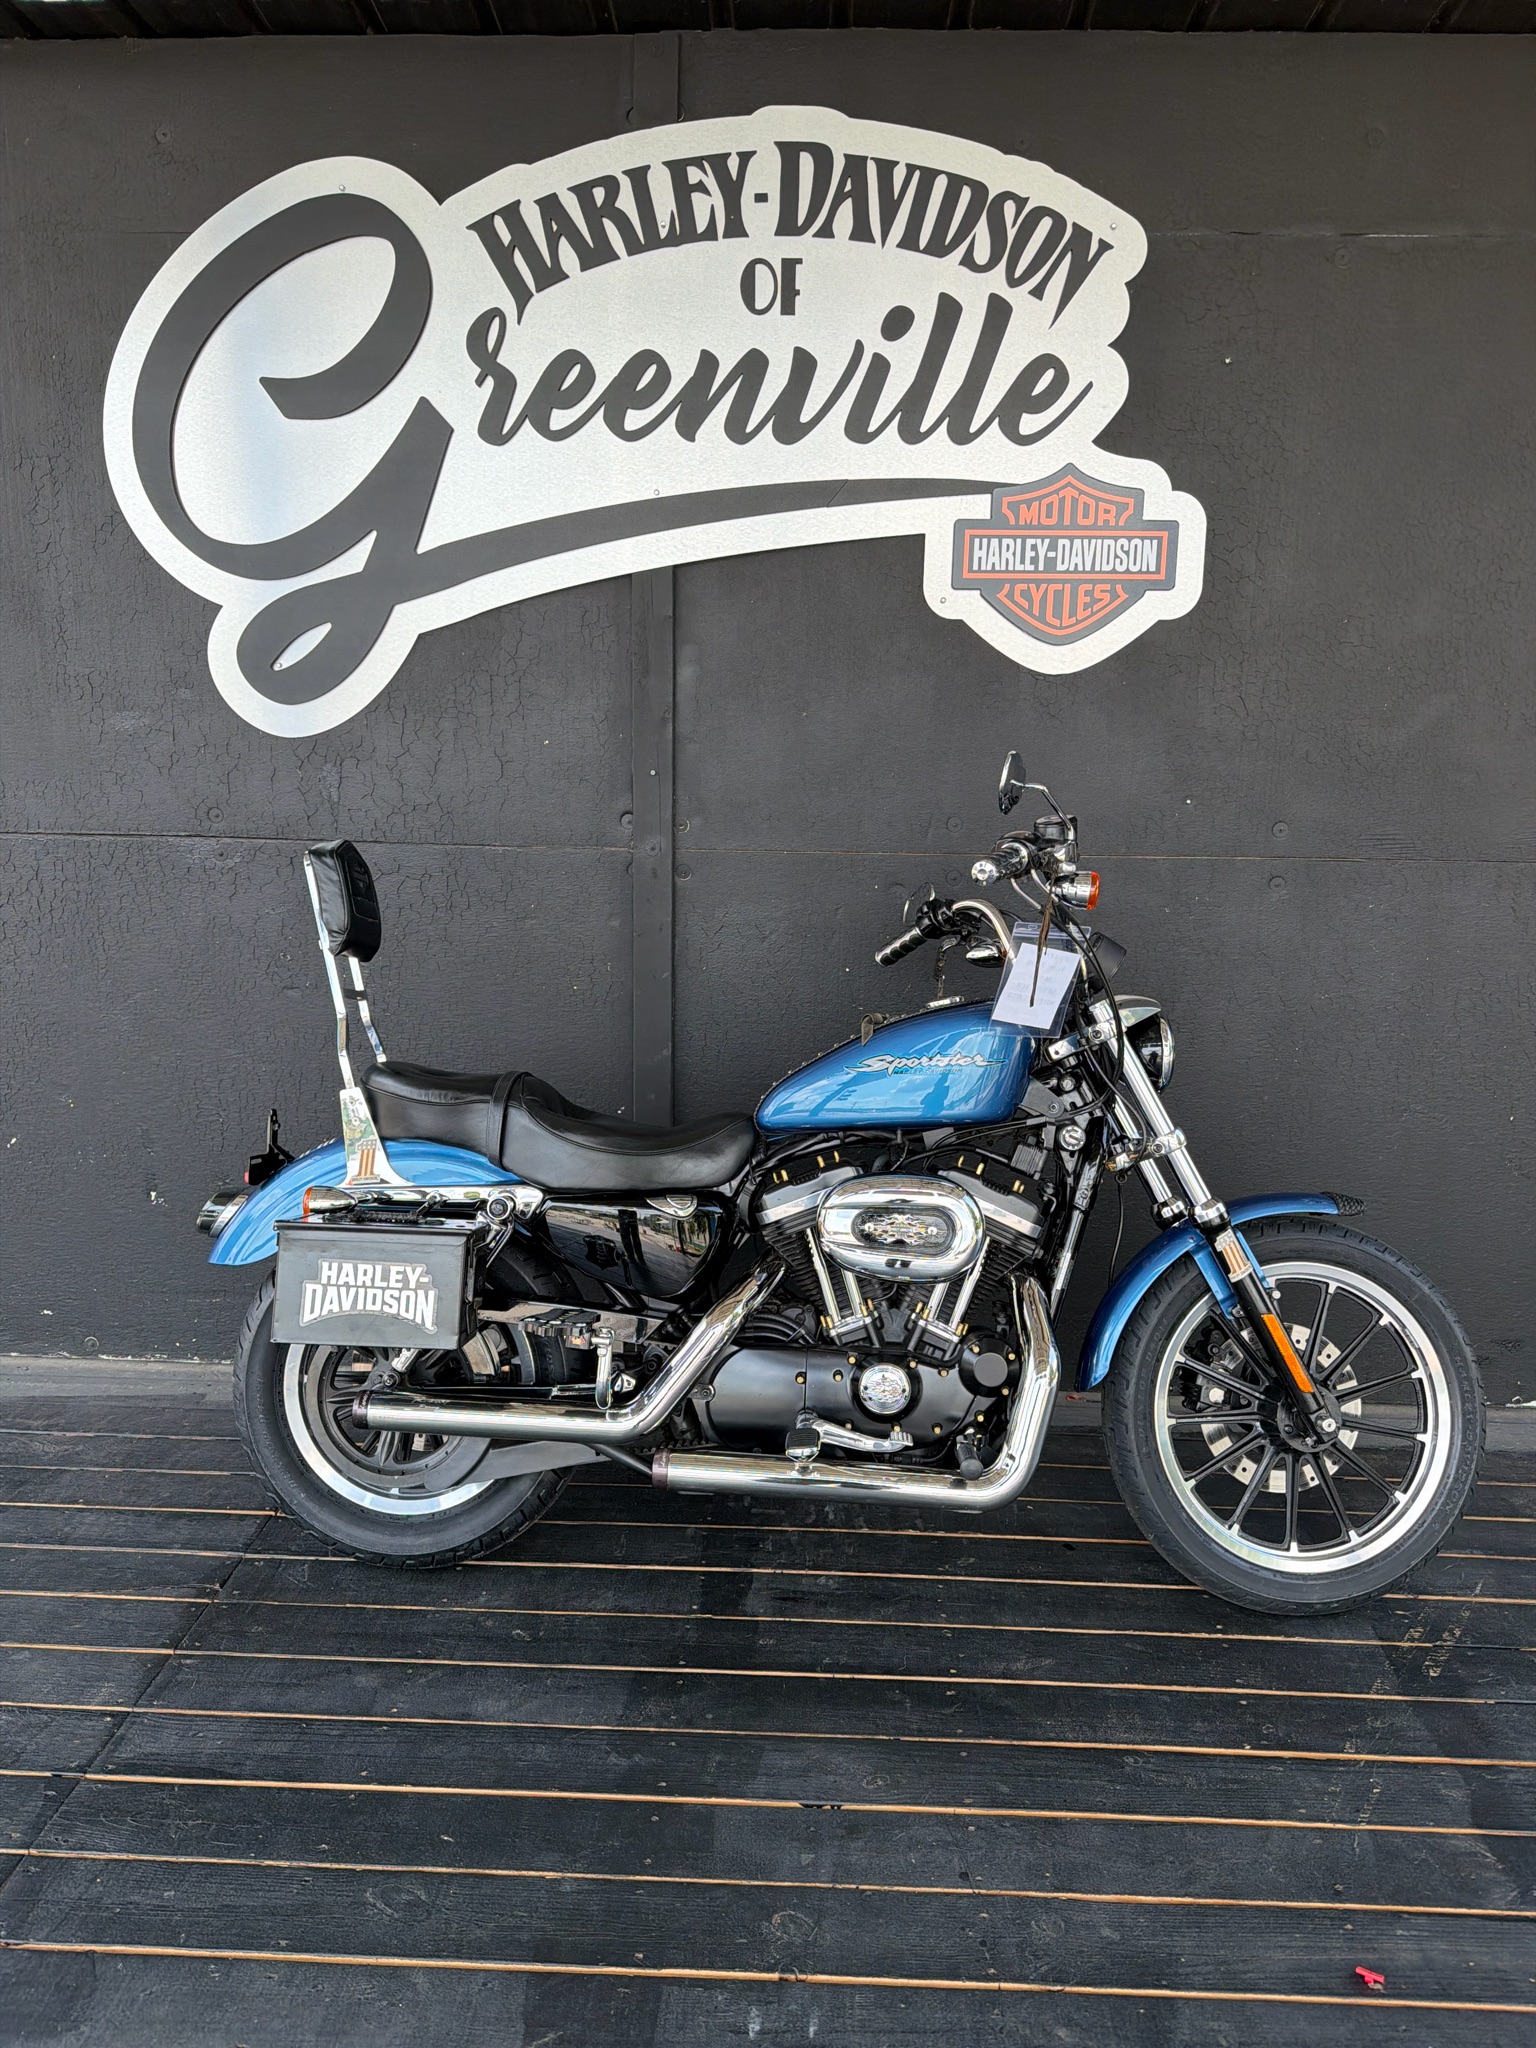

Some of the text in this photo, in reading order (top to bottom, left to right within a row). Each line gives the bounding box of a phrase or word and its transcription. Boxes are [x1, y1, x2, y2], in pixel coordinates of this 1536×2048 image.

[466, 141, 1115, 330] HARLEY-DAVIDSON
[740, 258, 803, 316] OF
[132, 193, 1094, 706] Greenville
[1018, 486, 1117, 526] MOTOR
[972, 538, 1158, 573] HARLEY-DAVIDSON
[1014, 583, 1111, 627] CYCLES
[844, 1052, 1007, 1076] Sportster
[320, 1261, 430, 1290] HARLEY-
[303, 1283, 436, 1331] DAVIDSON
